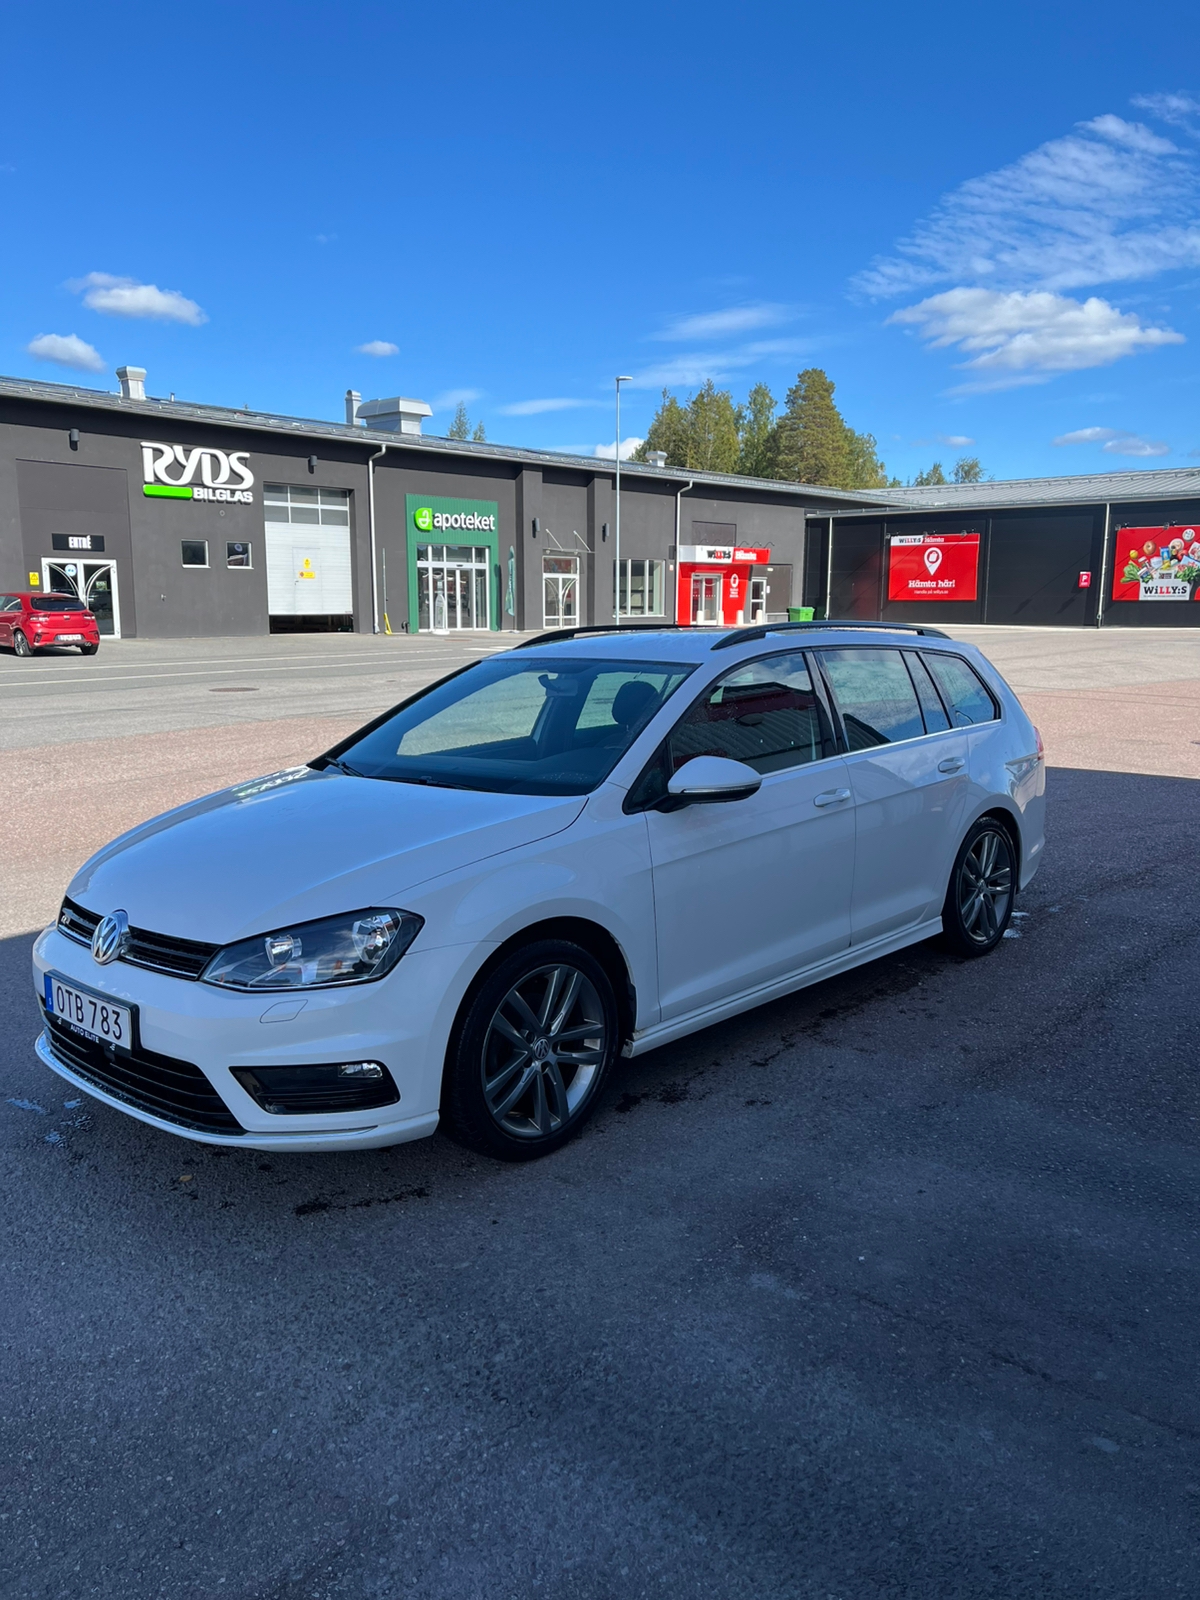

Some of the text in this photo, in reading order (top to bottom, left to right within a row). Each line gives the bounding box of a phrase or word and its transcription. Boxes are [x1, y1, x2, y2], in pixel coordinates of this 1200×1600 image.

[140, 441, 254, 490] RYDS
[193, 487, 253, 503] BILGLAS
[433, 511, 496, 531] apoteket
[68, 534, 92, 549] ENTRÉ
[908, 578, 956, 588] Hämta här!
[1143, 585, 1188, 595] WiLLY:S
[56, 985, 123, 1041] OTB 783
[70, 1024, 100, 1044] AUTO ELITE
